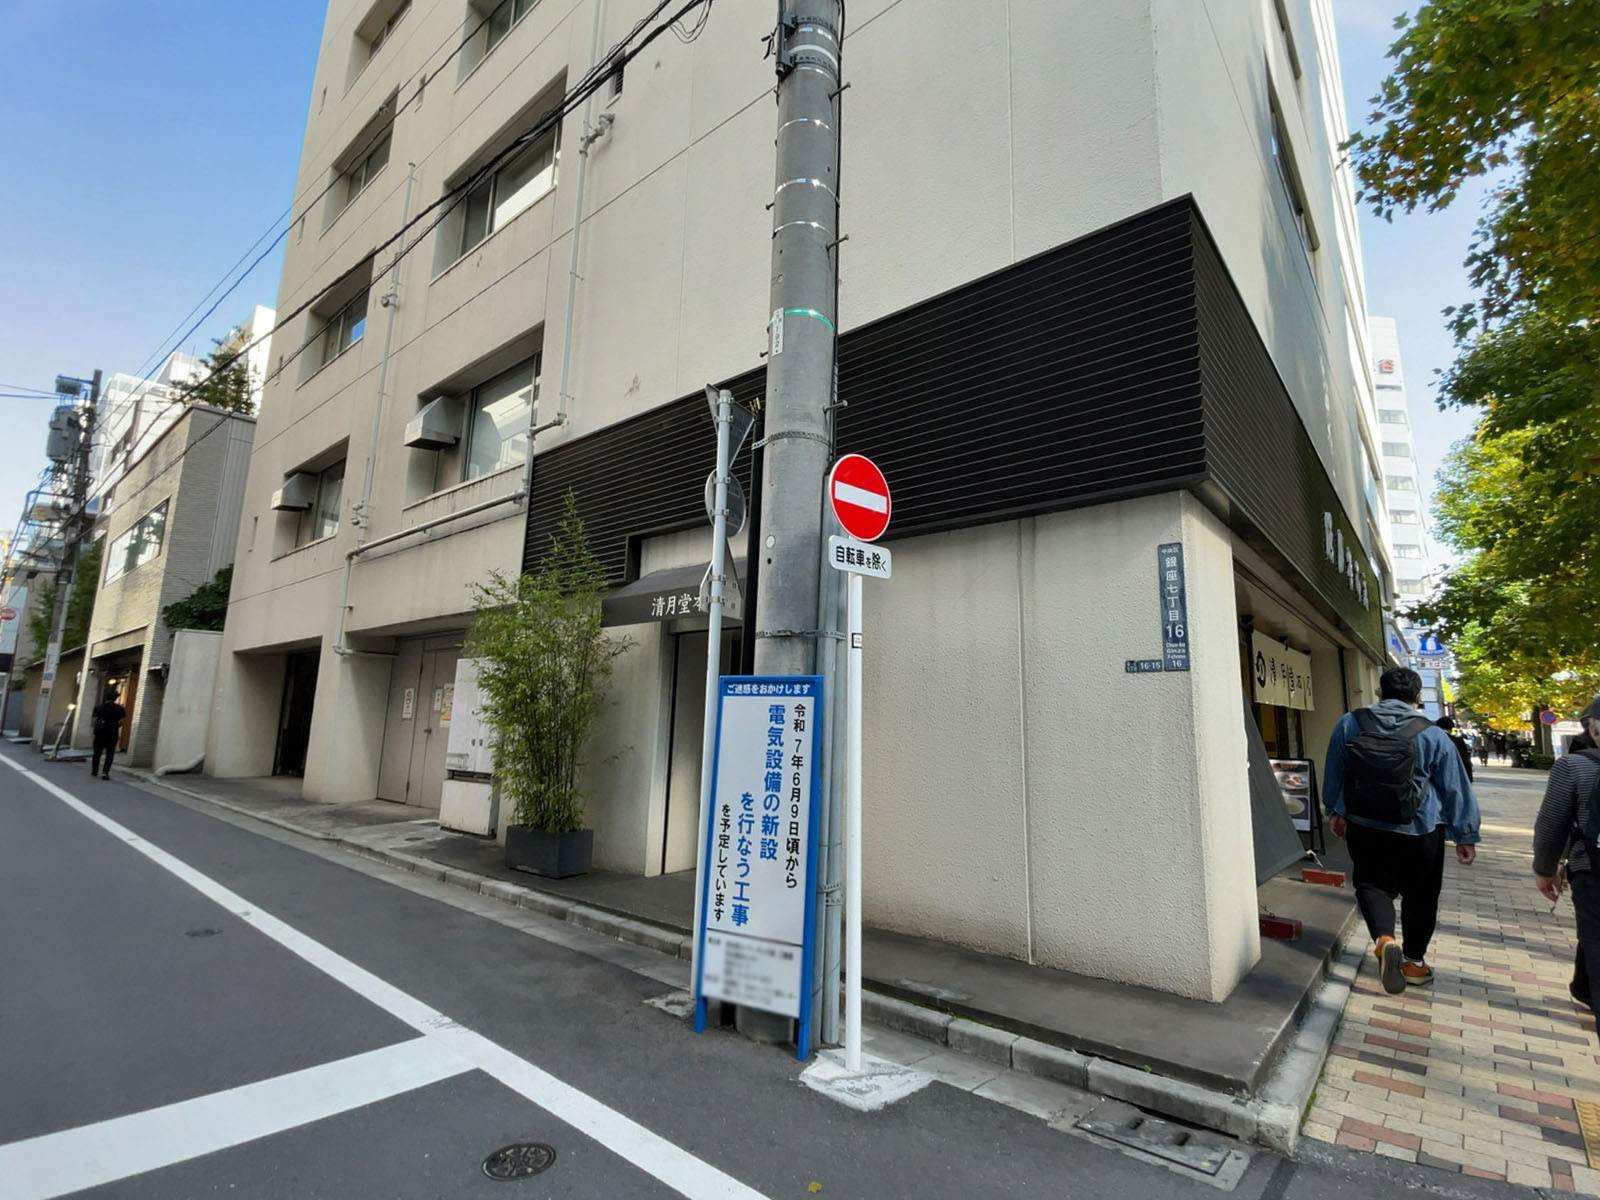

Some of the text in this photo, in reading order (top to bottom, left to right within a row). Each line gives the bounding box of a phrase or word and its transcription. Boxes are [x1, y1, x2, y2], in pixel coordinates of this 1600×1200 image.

[835, 544, 887, 572] 自転車を除く
[1165, 556, 1179, 621] 銀座七丁目
[1166, 624, 1184, 638] 16
[1172, 660, 1182, 668] 16
[727, 683, 811, 695] ご迷惑をおかけします
[759, 704, 786, 861] 電気設備の新設
[713, 804, 731, 922] を予定しています
[731, 792, 755, 927] を行なう工事
